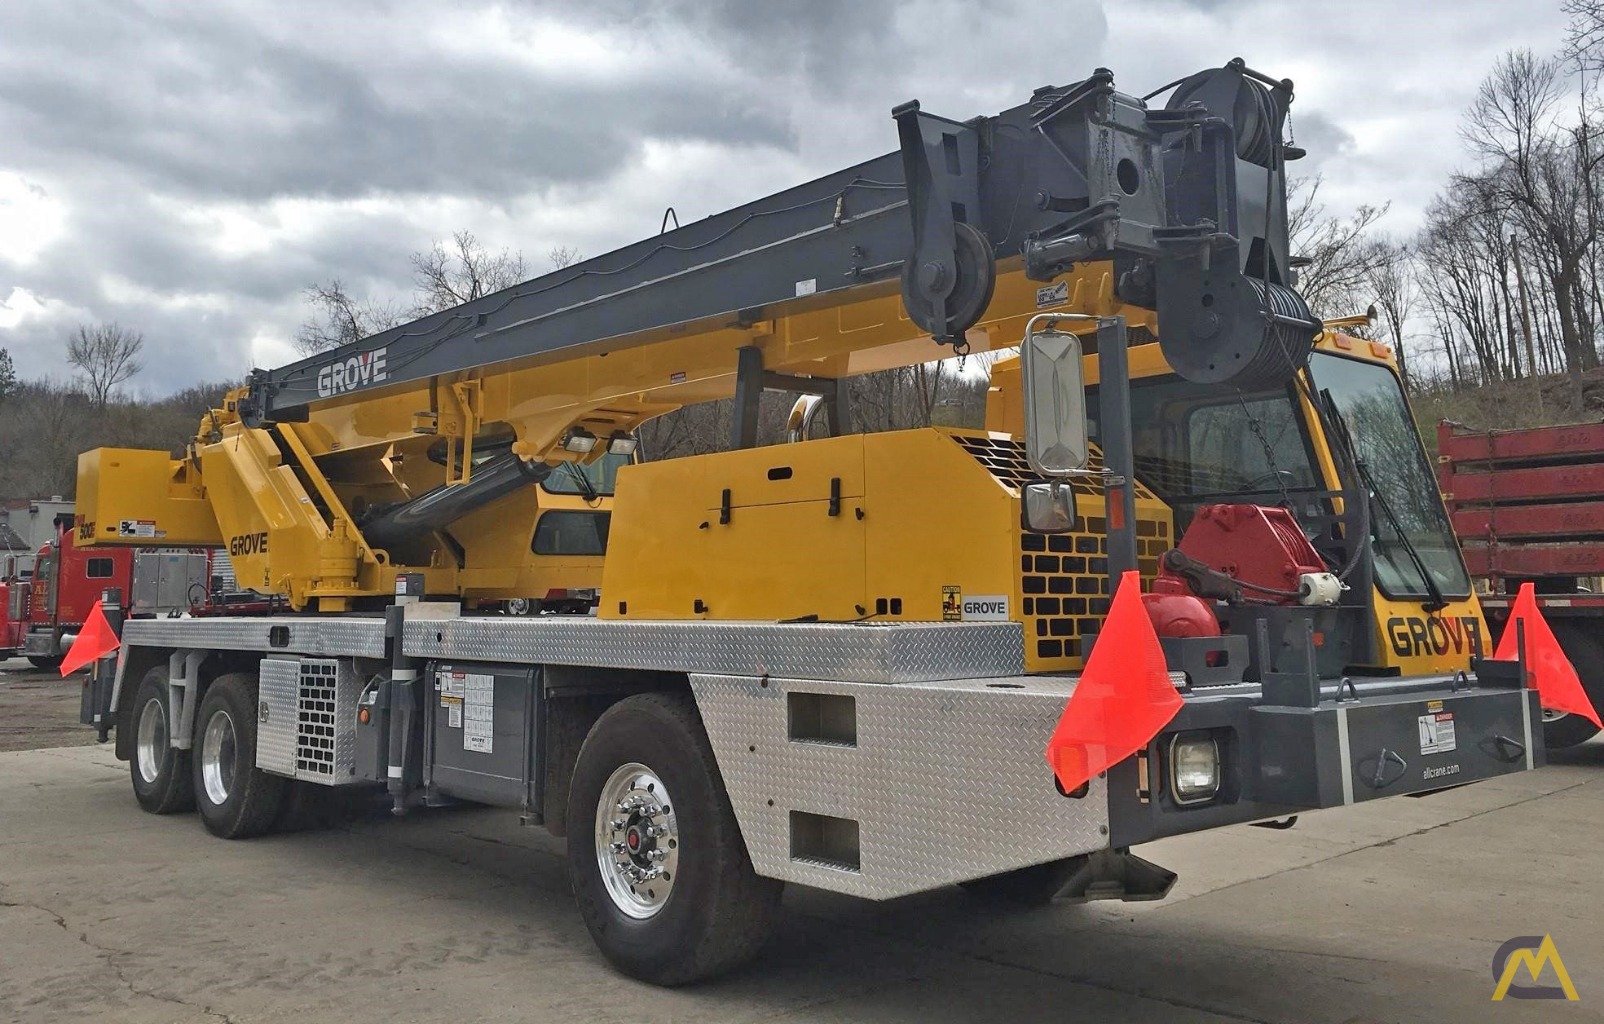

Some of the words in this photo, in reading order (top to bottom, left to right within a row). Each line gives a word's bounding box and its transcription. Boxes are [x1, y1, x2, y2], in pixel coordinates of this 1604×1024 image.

[317, 347, 387, 398] GROVE
[230, 532, 268, 556] GROVE
[964, 602, 1006, 614] GROVE
[1423, 764, 1460, 780] allcrane.com
